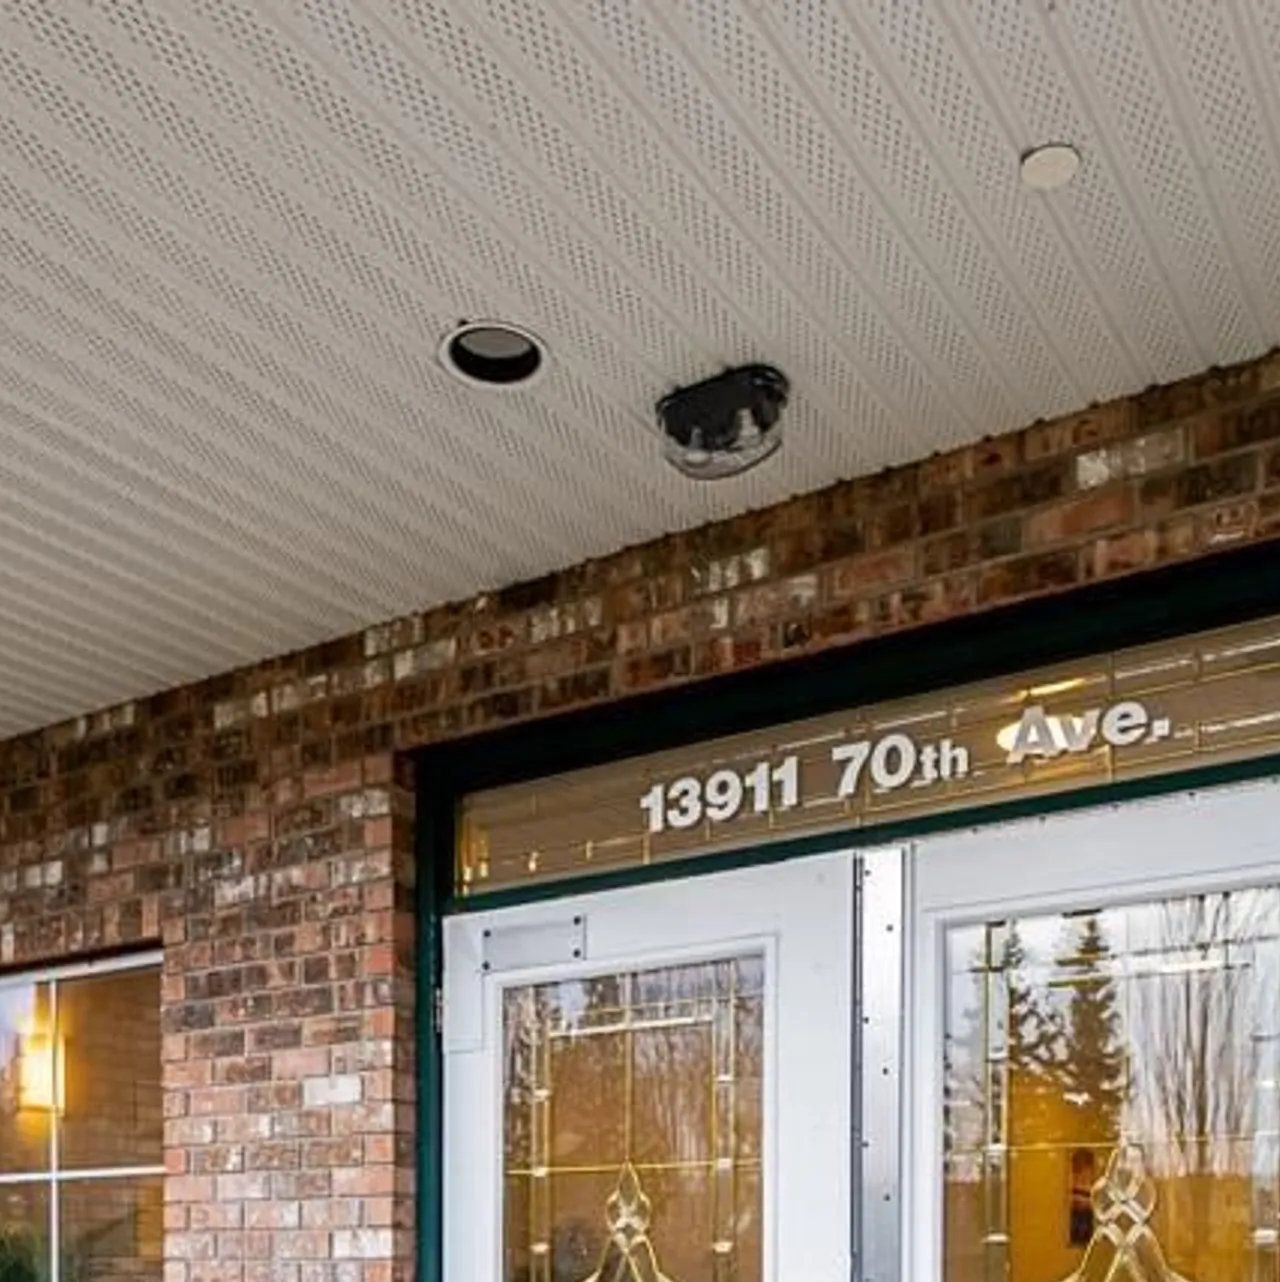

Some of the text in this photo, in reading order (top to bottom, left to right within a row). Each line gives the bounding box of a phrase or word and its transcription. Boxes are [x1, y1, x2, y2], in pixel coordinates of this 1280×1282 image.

[640, 701, 1170, 833] 13911 70th Ave.
